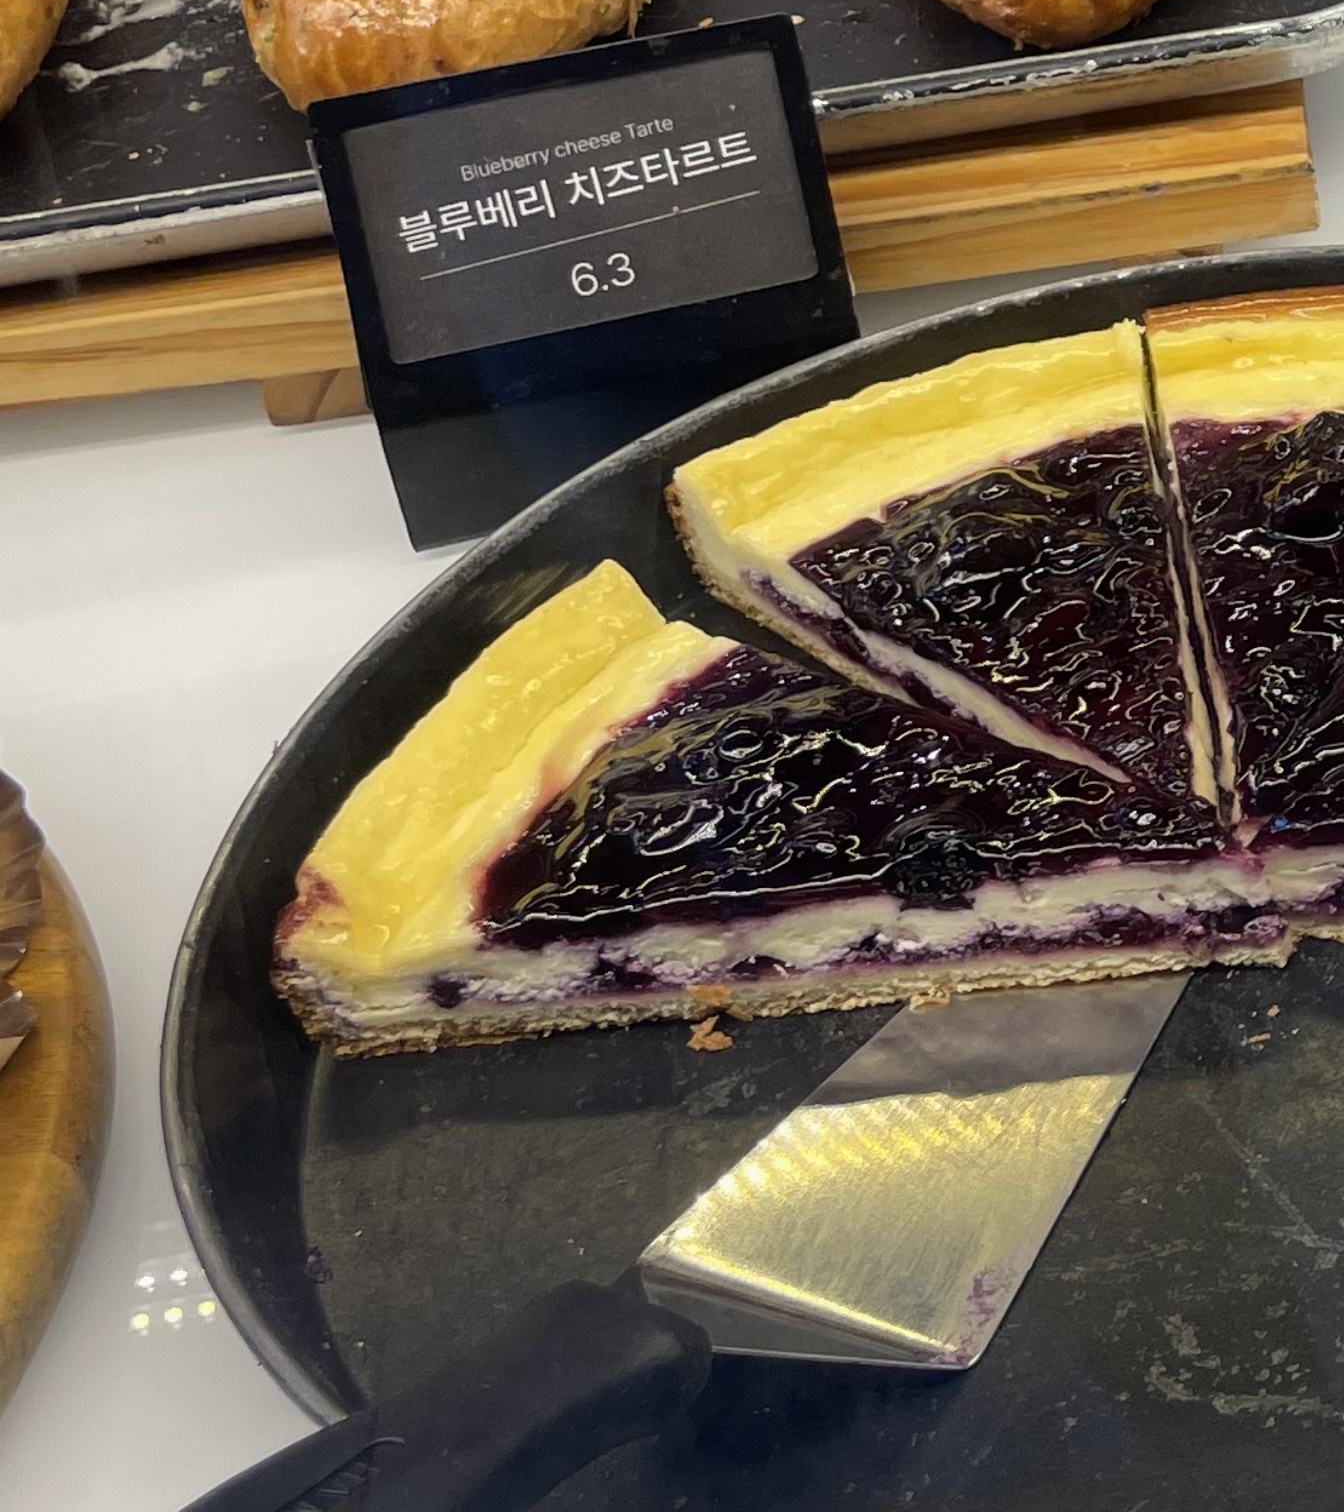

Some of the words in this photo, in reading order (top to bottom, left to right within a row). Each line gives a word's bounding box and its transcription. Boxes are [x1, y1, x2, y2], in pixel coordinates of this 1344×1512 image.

[460, 148, 549, 182] Blueberry
[554, 130, 622, 159] cheese
[624, 116, 674, 140] Tarte
[398, 179, 557, 253] 블루베리
[564, 131, 757, 206] 치즈타르트
[570, 252, 636, 296] 6.3
